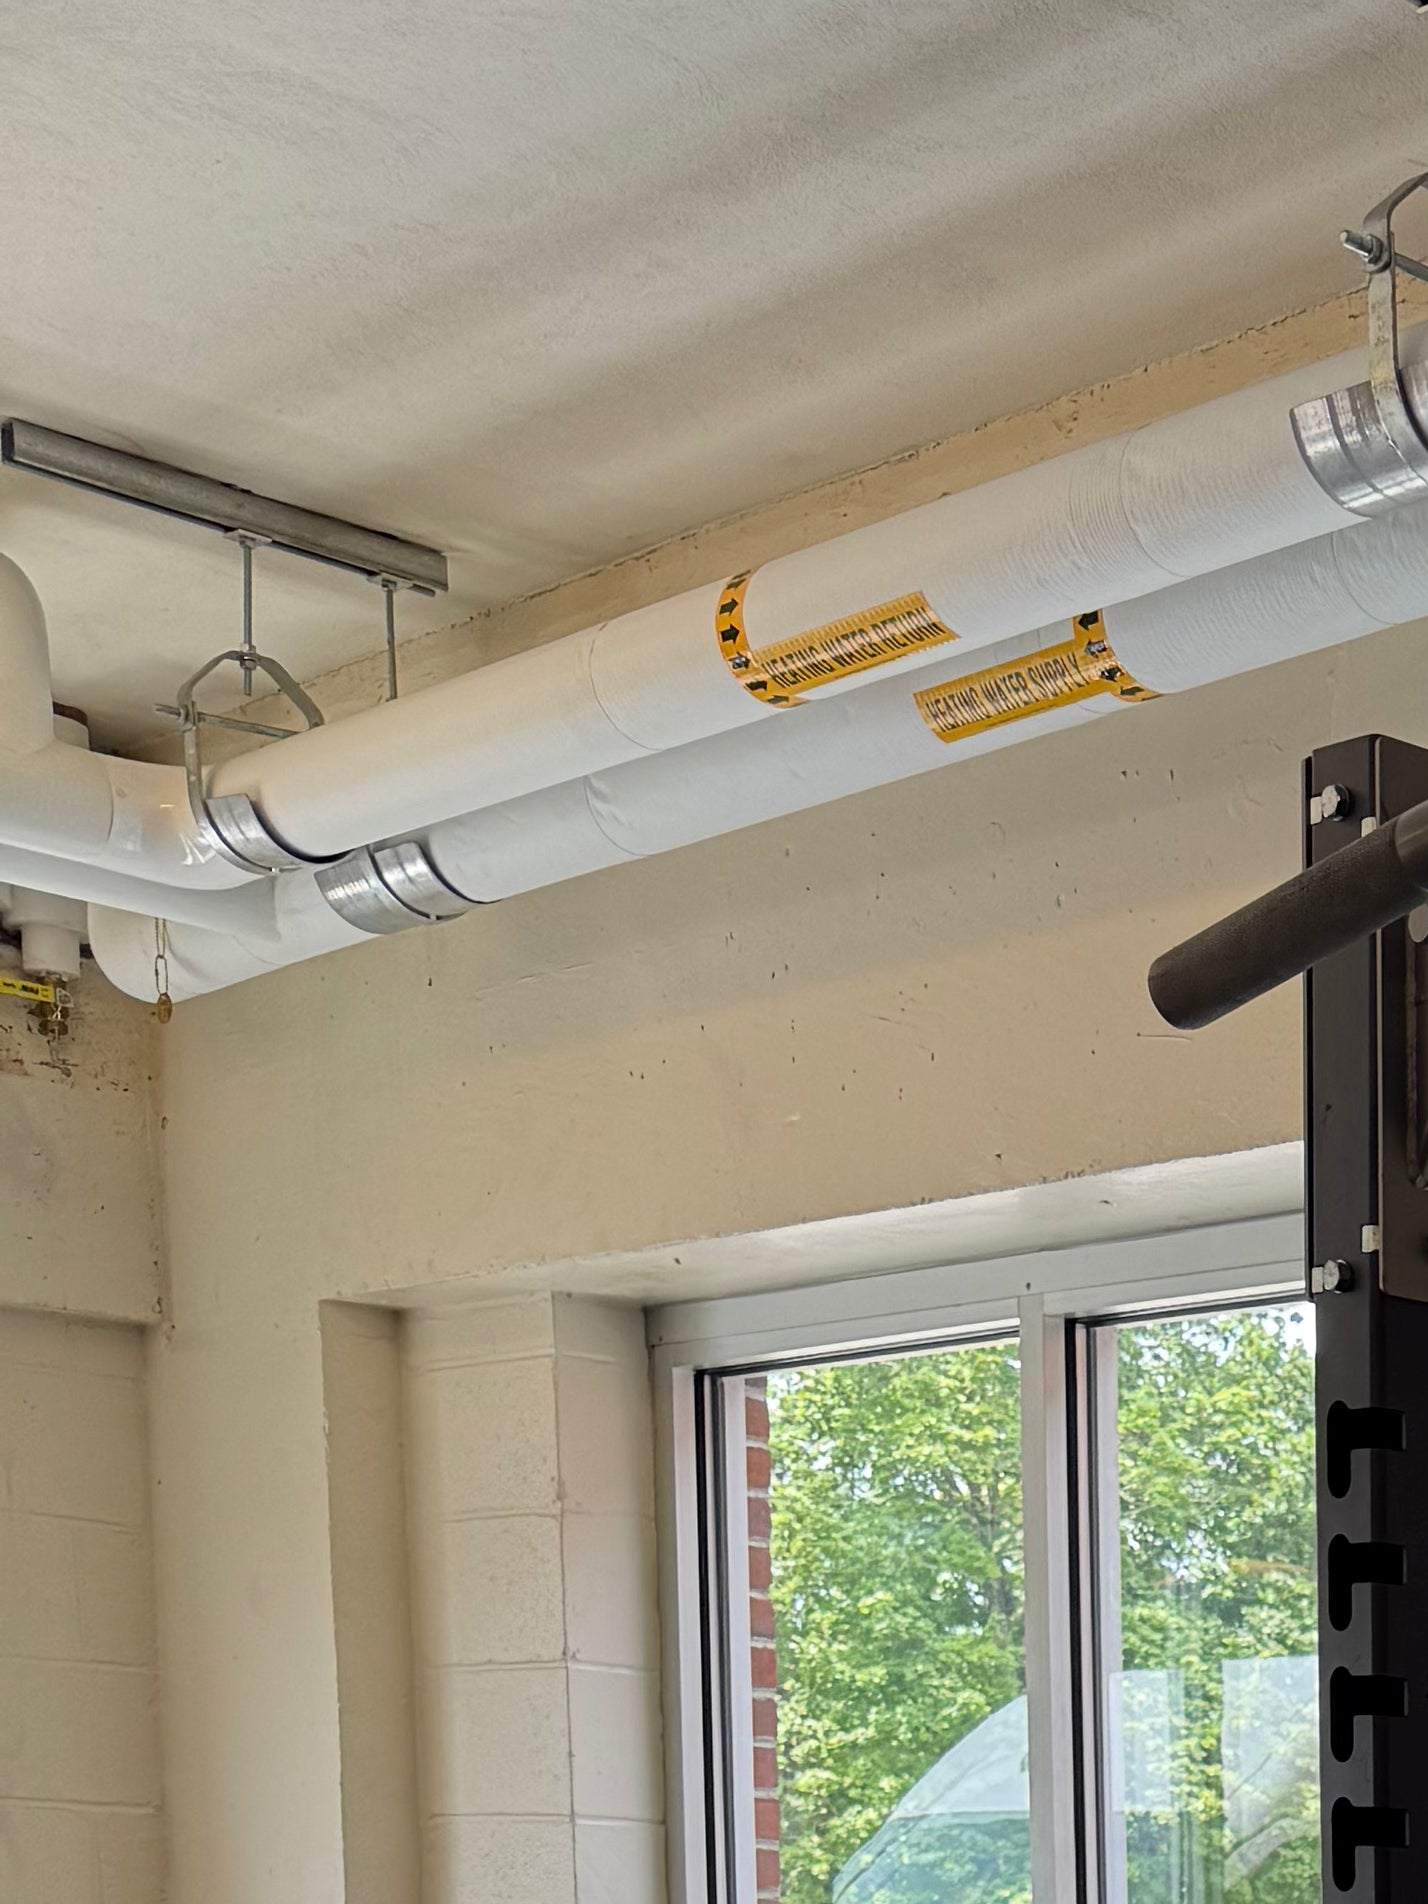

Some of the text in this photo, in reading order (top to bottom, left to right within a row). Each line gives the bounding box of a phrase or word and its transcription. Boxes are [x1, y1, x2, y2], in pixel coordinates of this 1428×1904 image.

[762, 607, 947, 687] HEATING WATER RETURN
[925, 654, 1091, 733] HEATING WATER SUPPLY
